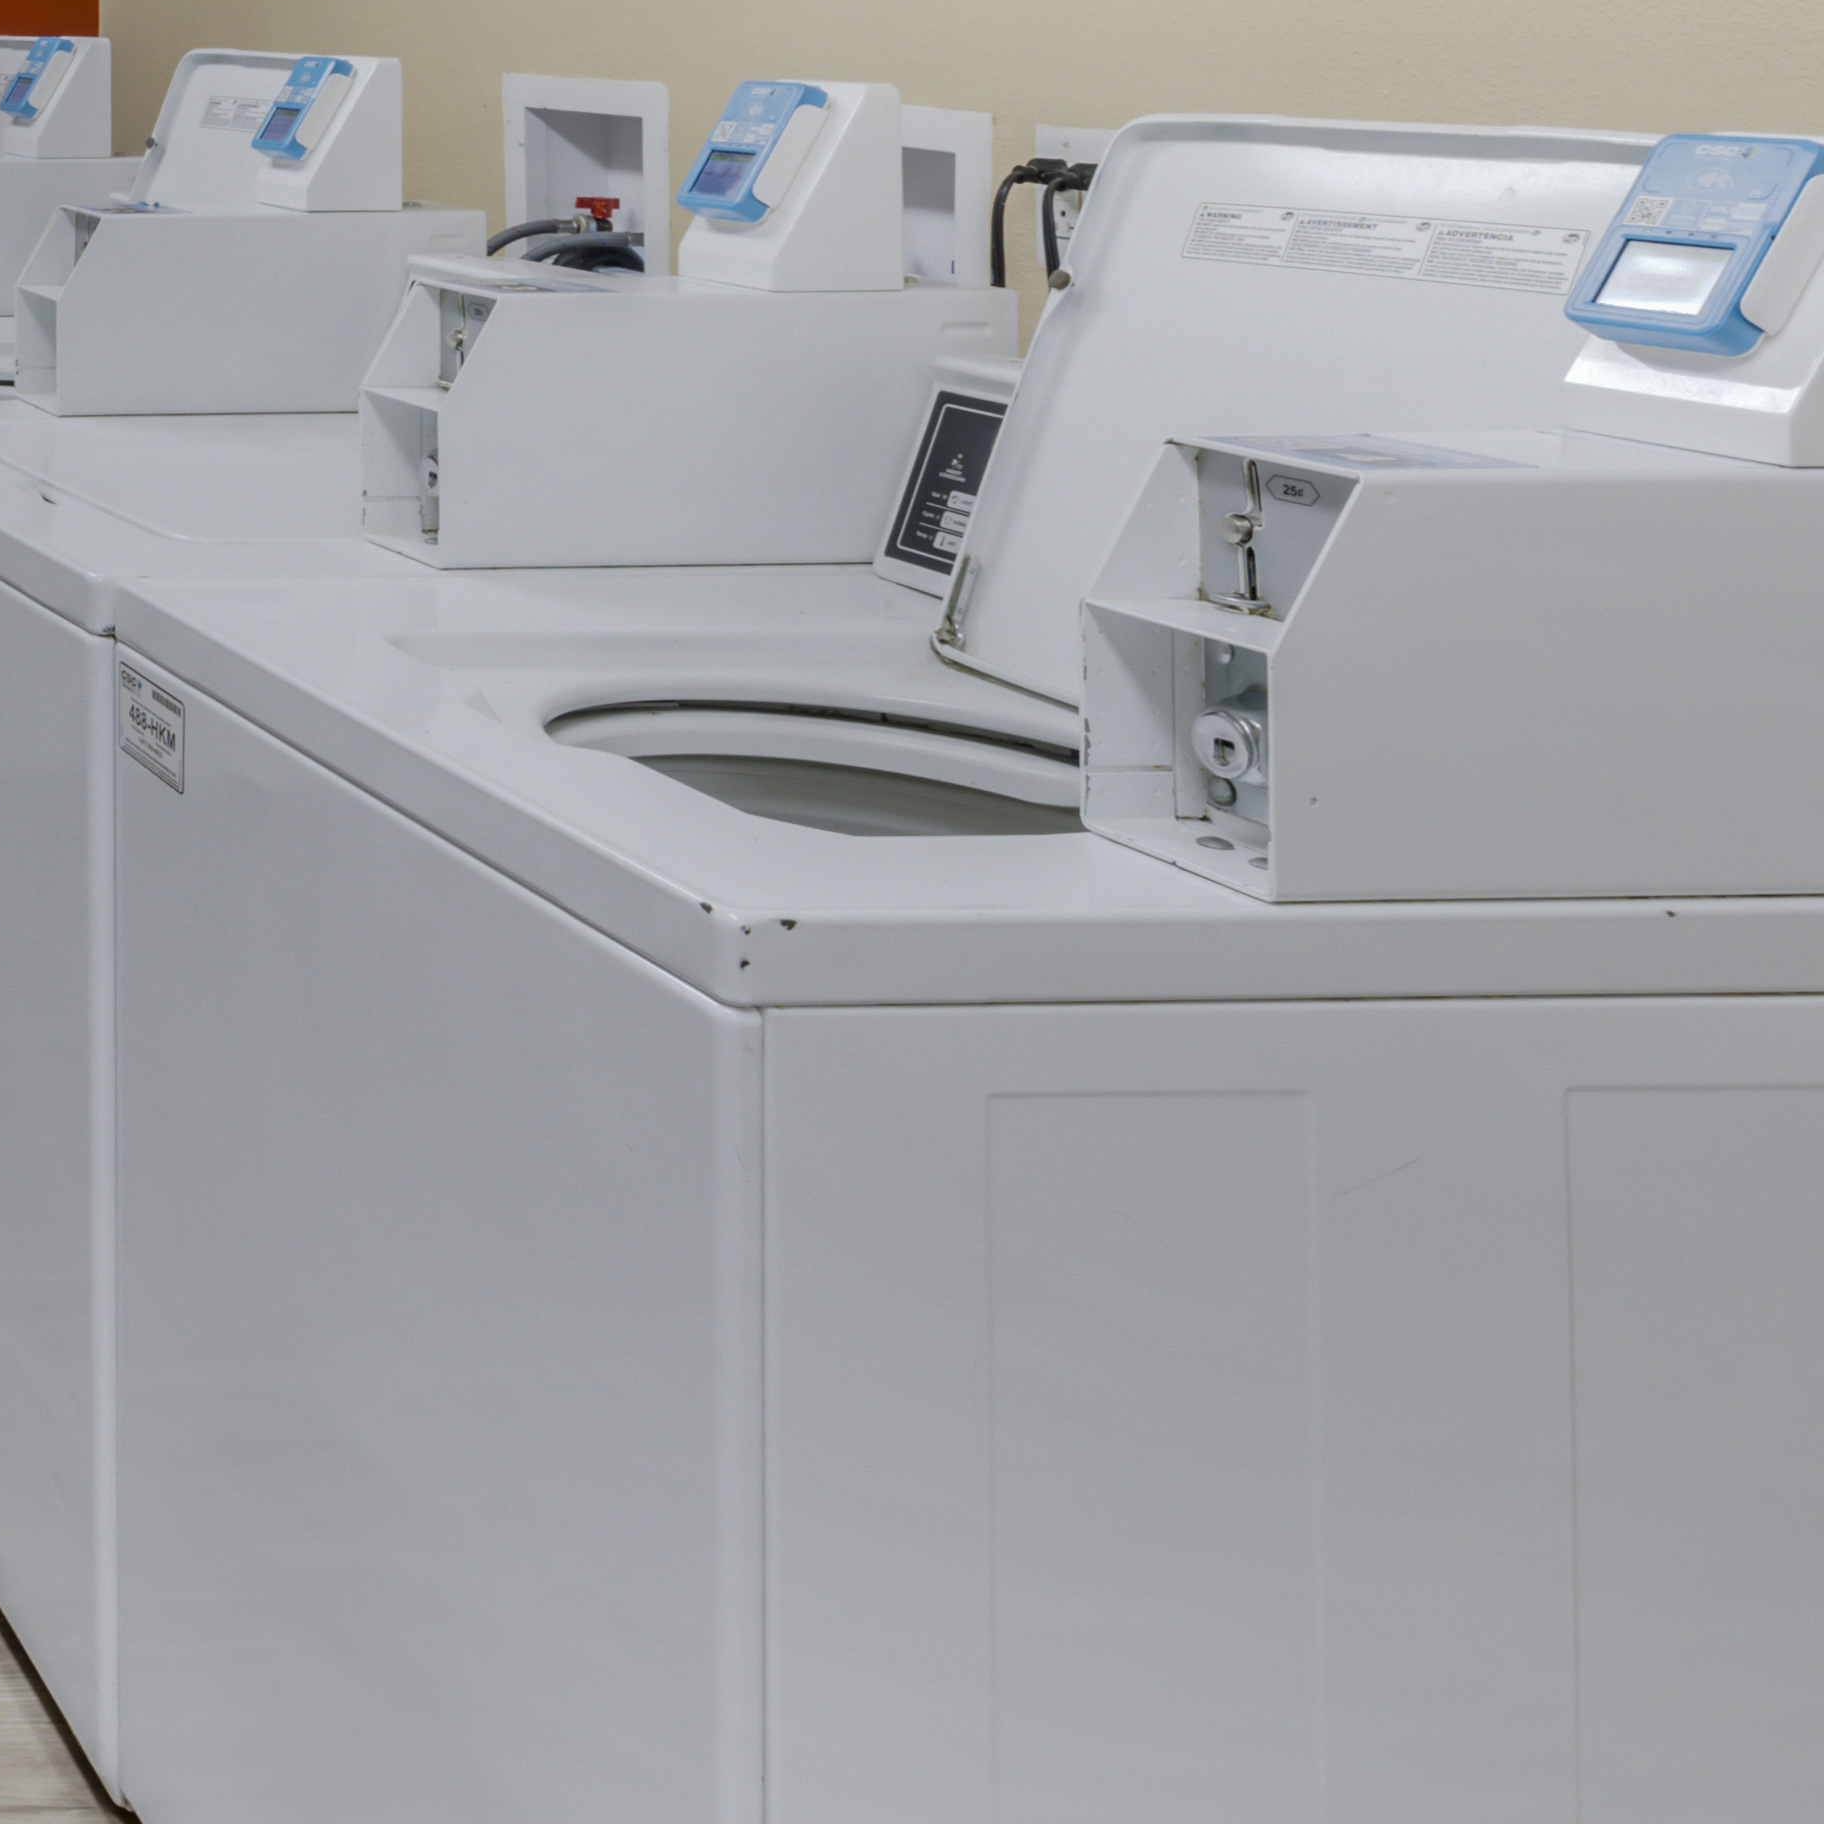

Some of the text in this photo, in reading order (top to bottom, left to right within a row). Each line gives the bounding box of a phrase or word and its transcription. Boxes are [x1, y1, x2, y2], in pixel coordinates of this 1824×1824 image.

[1696, 144, 1740, 156] CSC
[1446, 229, 1514, 241] ADVERTENCIA
[129, 704, 176, 752] 488-HKM
